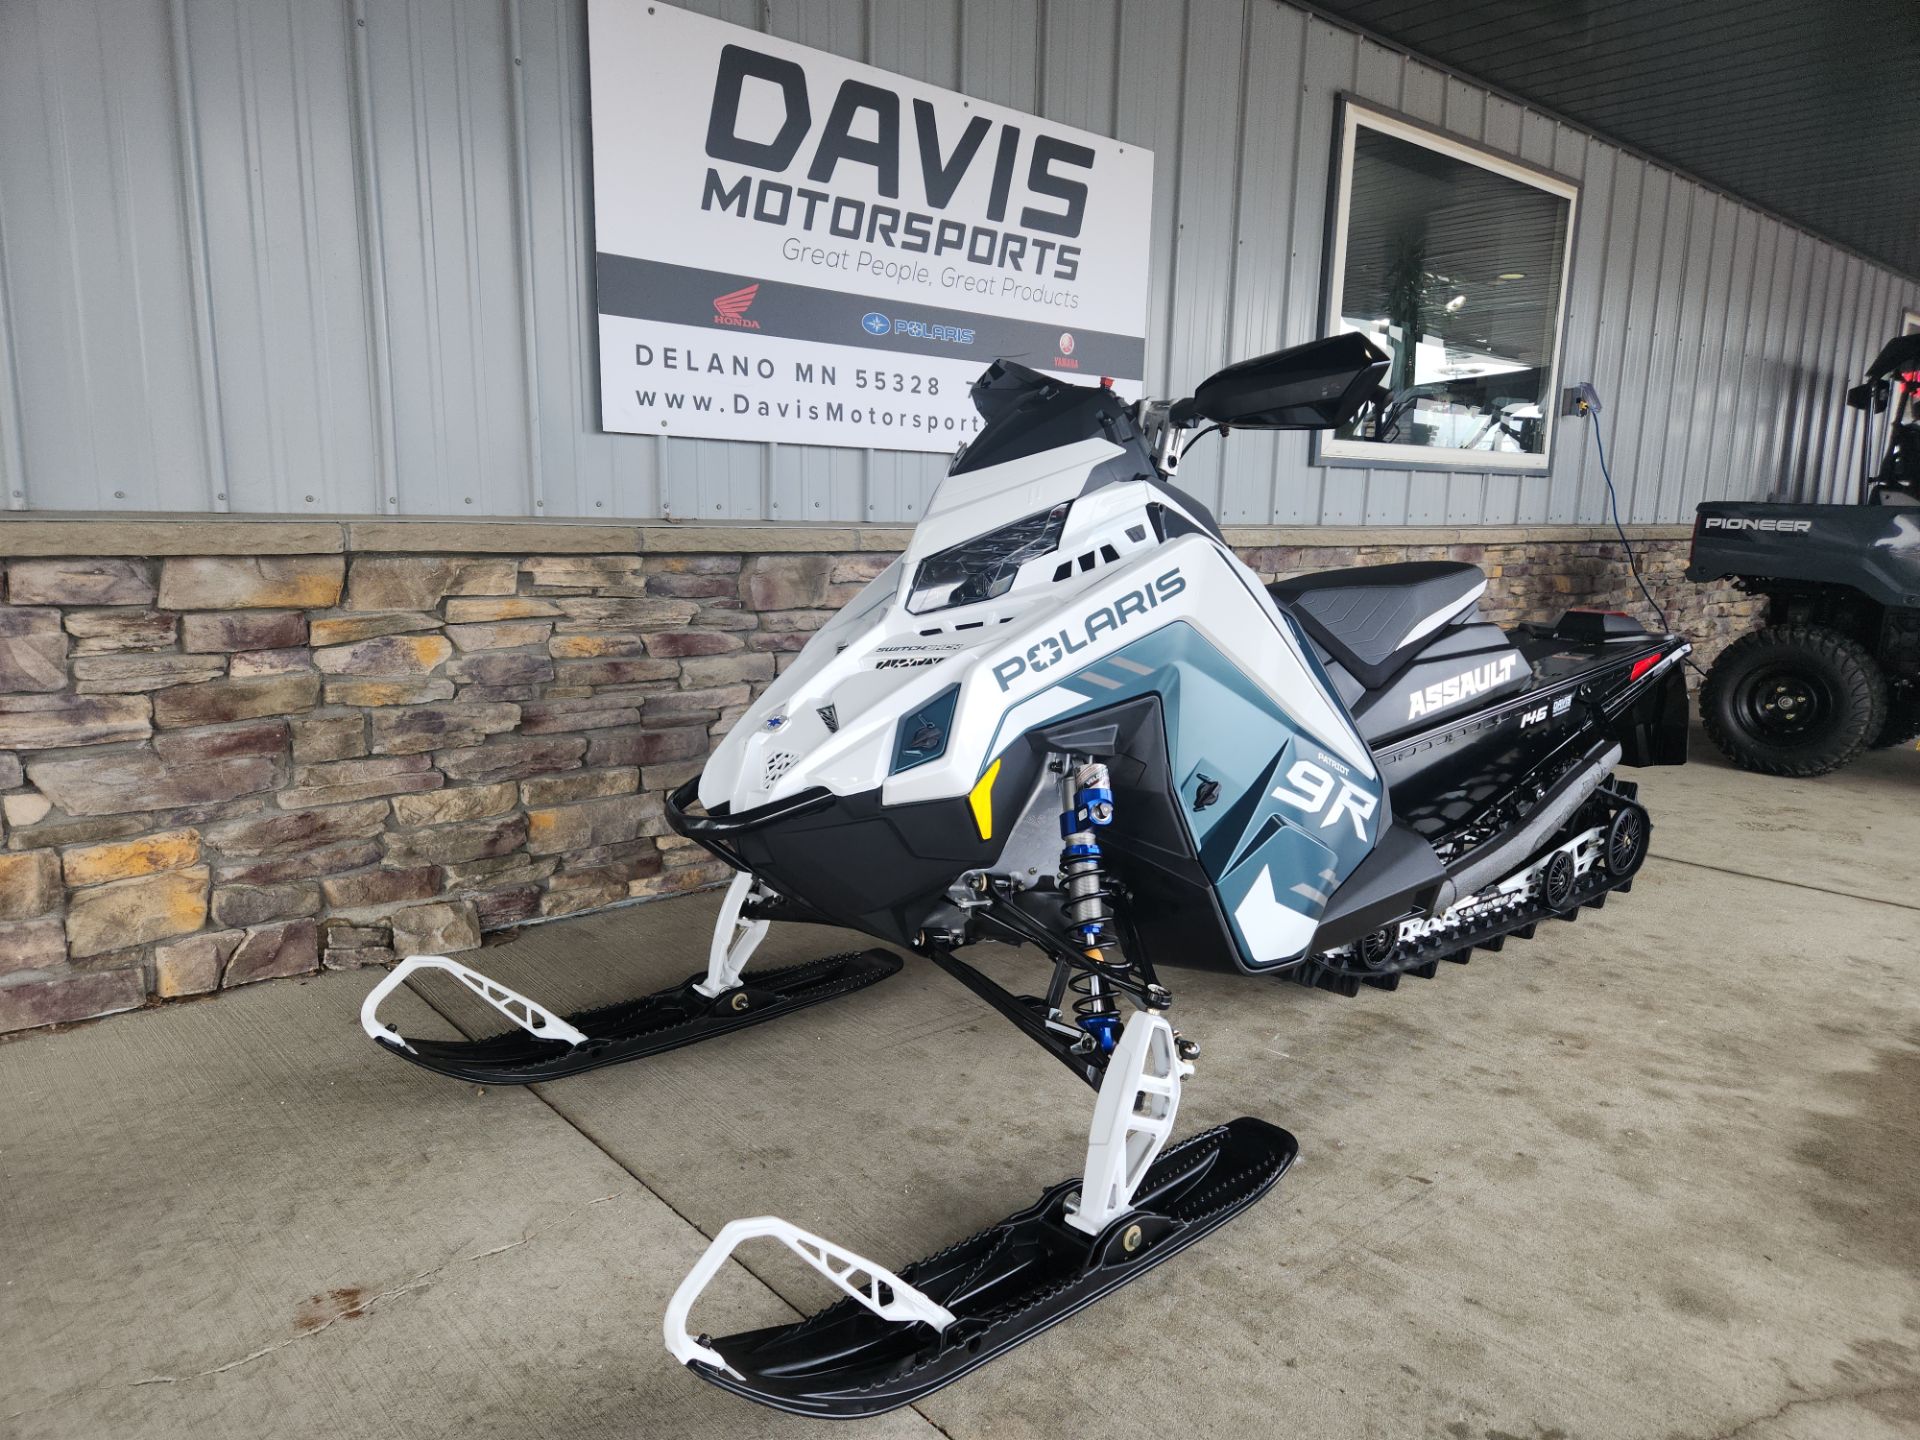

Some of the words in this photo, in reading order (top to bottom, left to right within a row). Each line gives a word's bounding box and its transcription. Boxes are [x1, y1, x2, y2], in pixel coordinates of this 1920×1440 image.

[705, 44, 1096, 238] DAVIS
[701, 167, 1081, 281] MOTORSPORTS
[782, 237, 849, 270] Great
[856, 250, 932, 286] People,
[941, 267, 996, 296] Great
[1001, 276, 1079, 309] Products
[714, 315, 760, 329] HONDA
[894, 319, 975, 344] POLARIS
[635, 343, 775, 379] DELANO
[795, 362, 836, 386] MN
[855, 368, 939, 396] 55328
[1705, 518, 1811, 532] PIONEER
[992, 567, 1186, 693] POLARIS
[1408, 654, 1516, 720] ASSAULT
[1520, 705, 1548, 728] 146
[1318, 752, 1350, 777] PATRIOT
[1271, 760, 1378, 843] 9R
